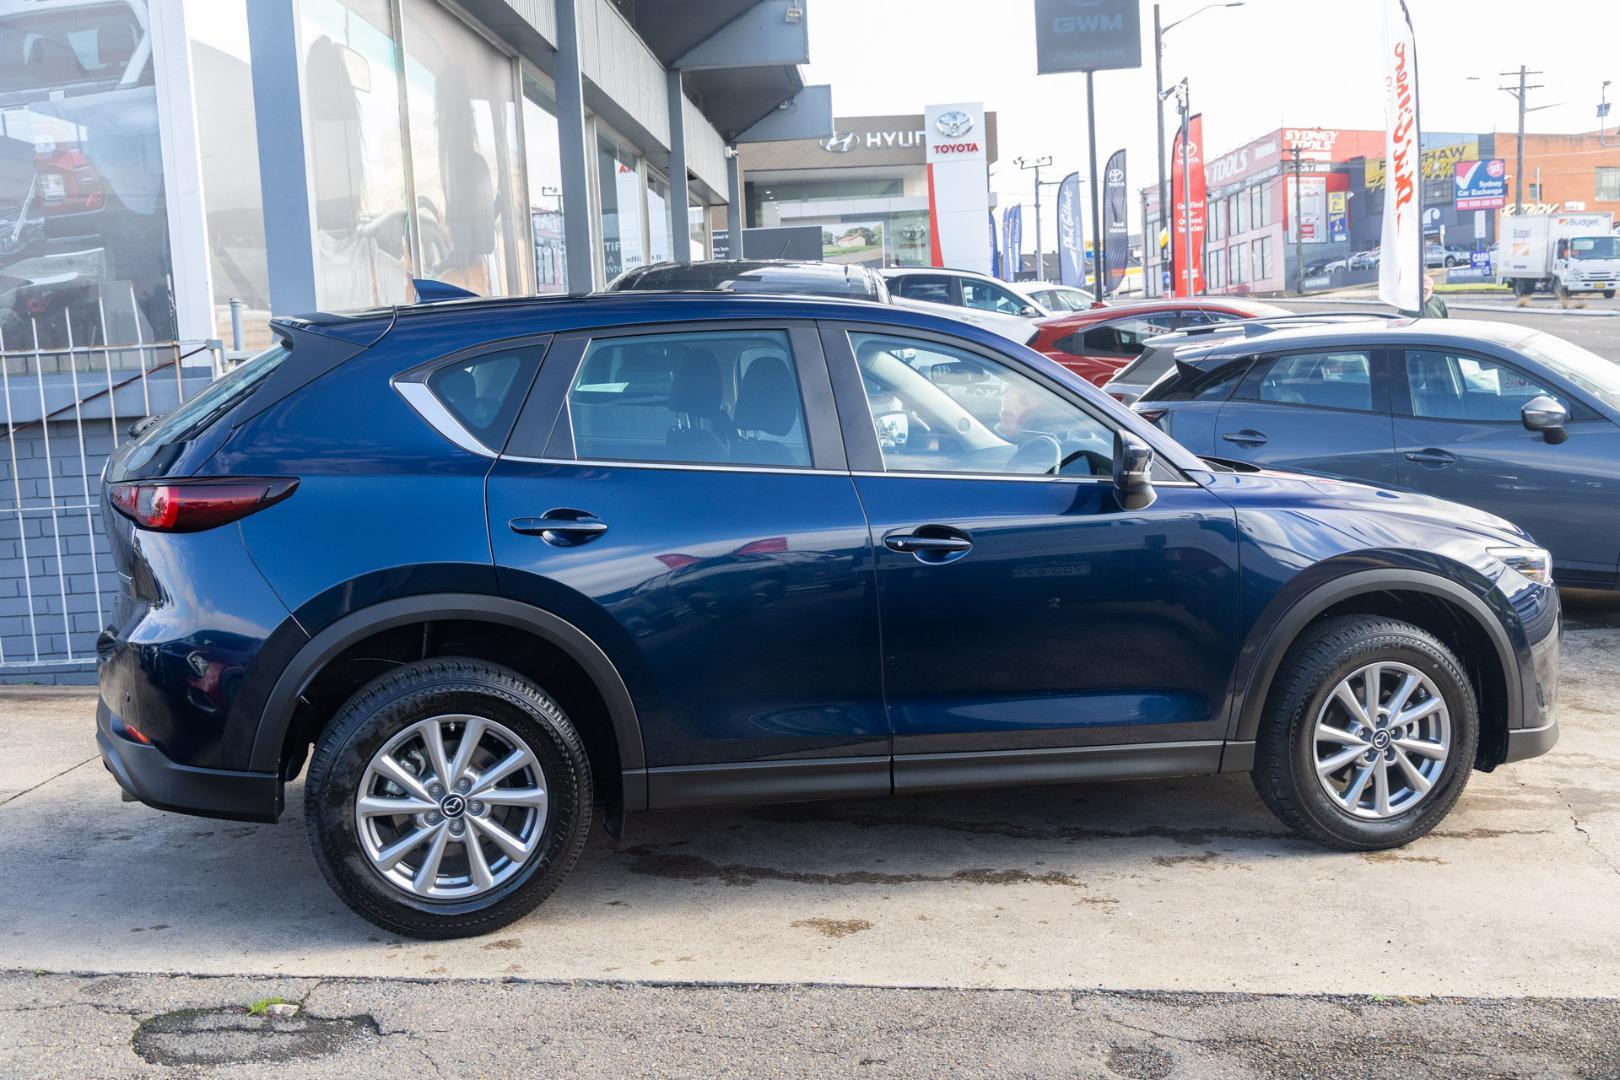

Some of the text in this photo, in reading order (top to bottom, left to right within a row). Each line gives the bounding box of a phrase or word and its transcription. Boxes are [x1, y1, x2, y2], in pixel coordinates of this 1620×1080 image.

[1053, 14, 1123, 33] GWM
[1284, 130, 1340, 142] SYDNEY
[933, 142, 980, 155] TOYOTA
[1290, 140, 1332, 152] TOOLS
[1212, 149, 1248, 183] TOOLS
[1478, 180, 1503, 188] Sydney
[1471, 188, 1504, 197] Exchange
[1568, 218, 1600, 229] Budget
[1472, 252, 1490, 262] CASH
